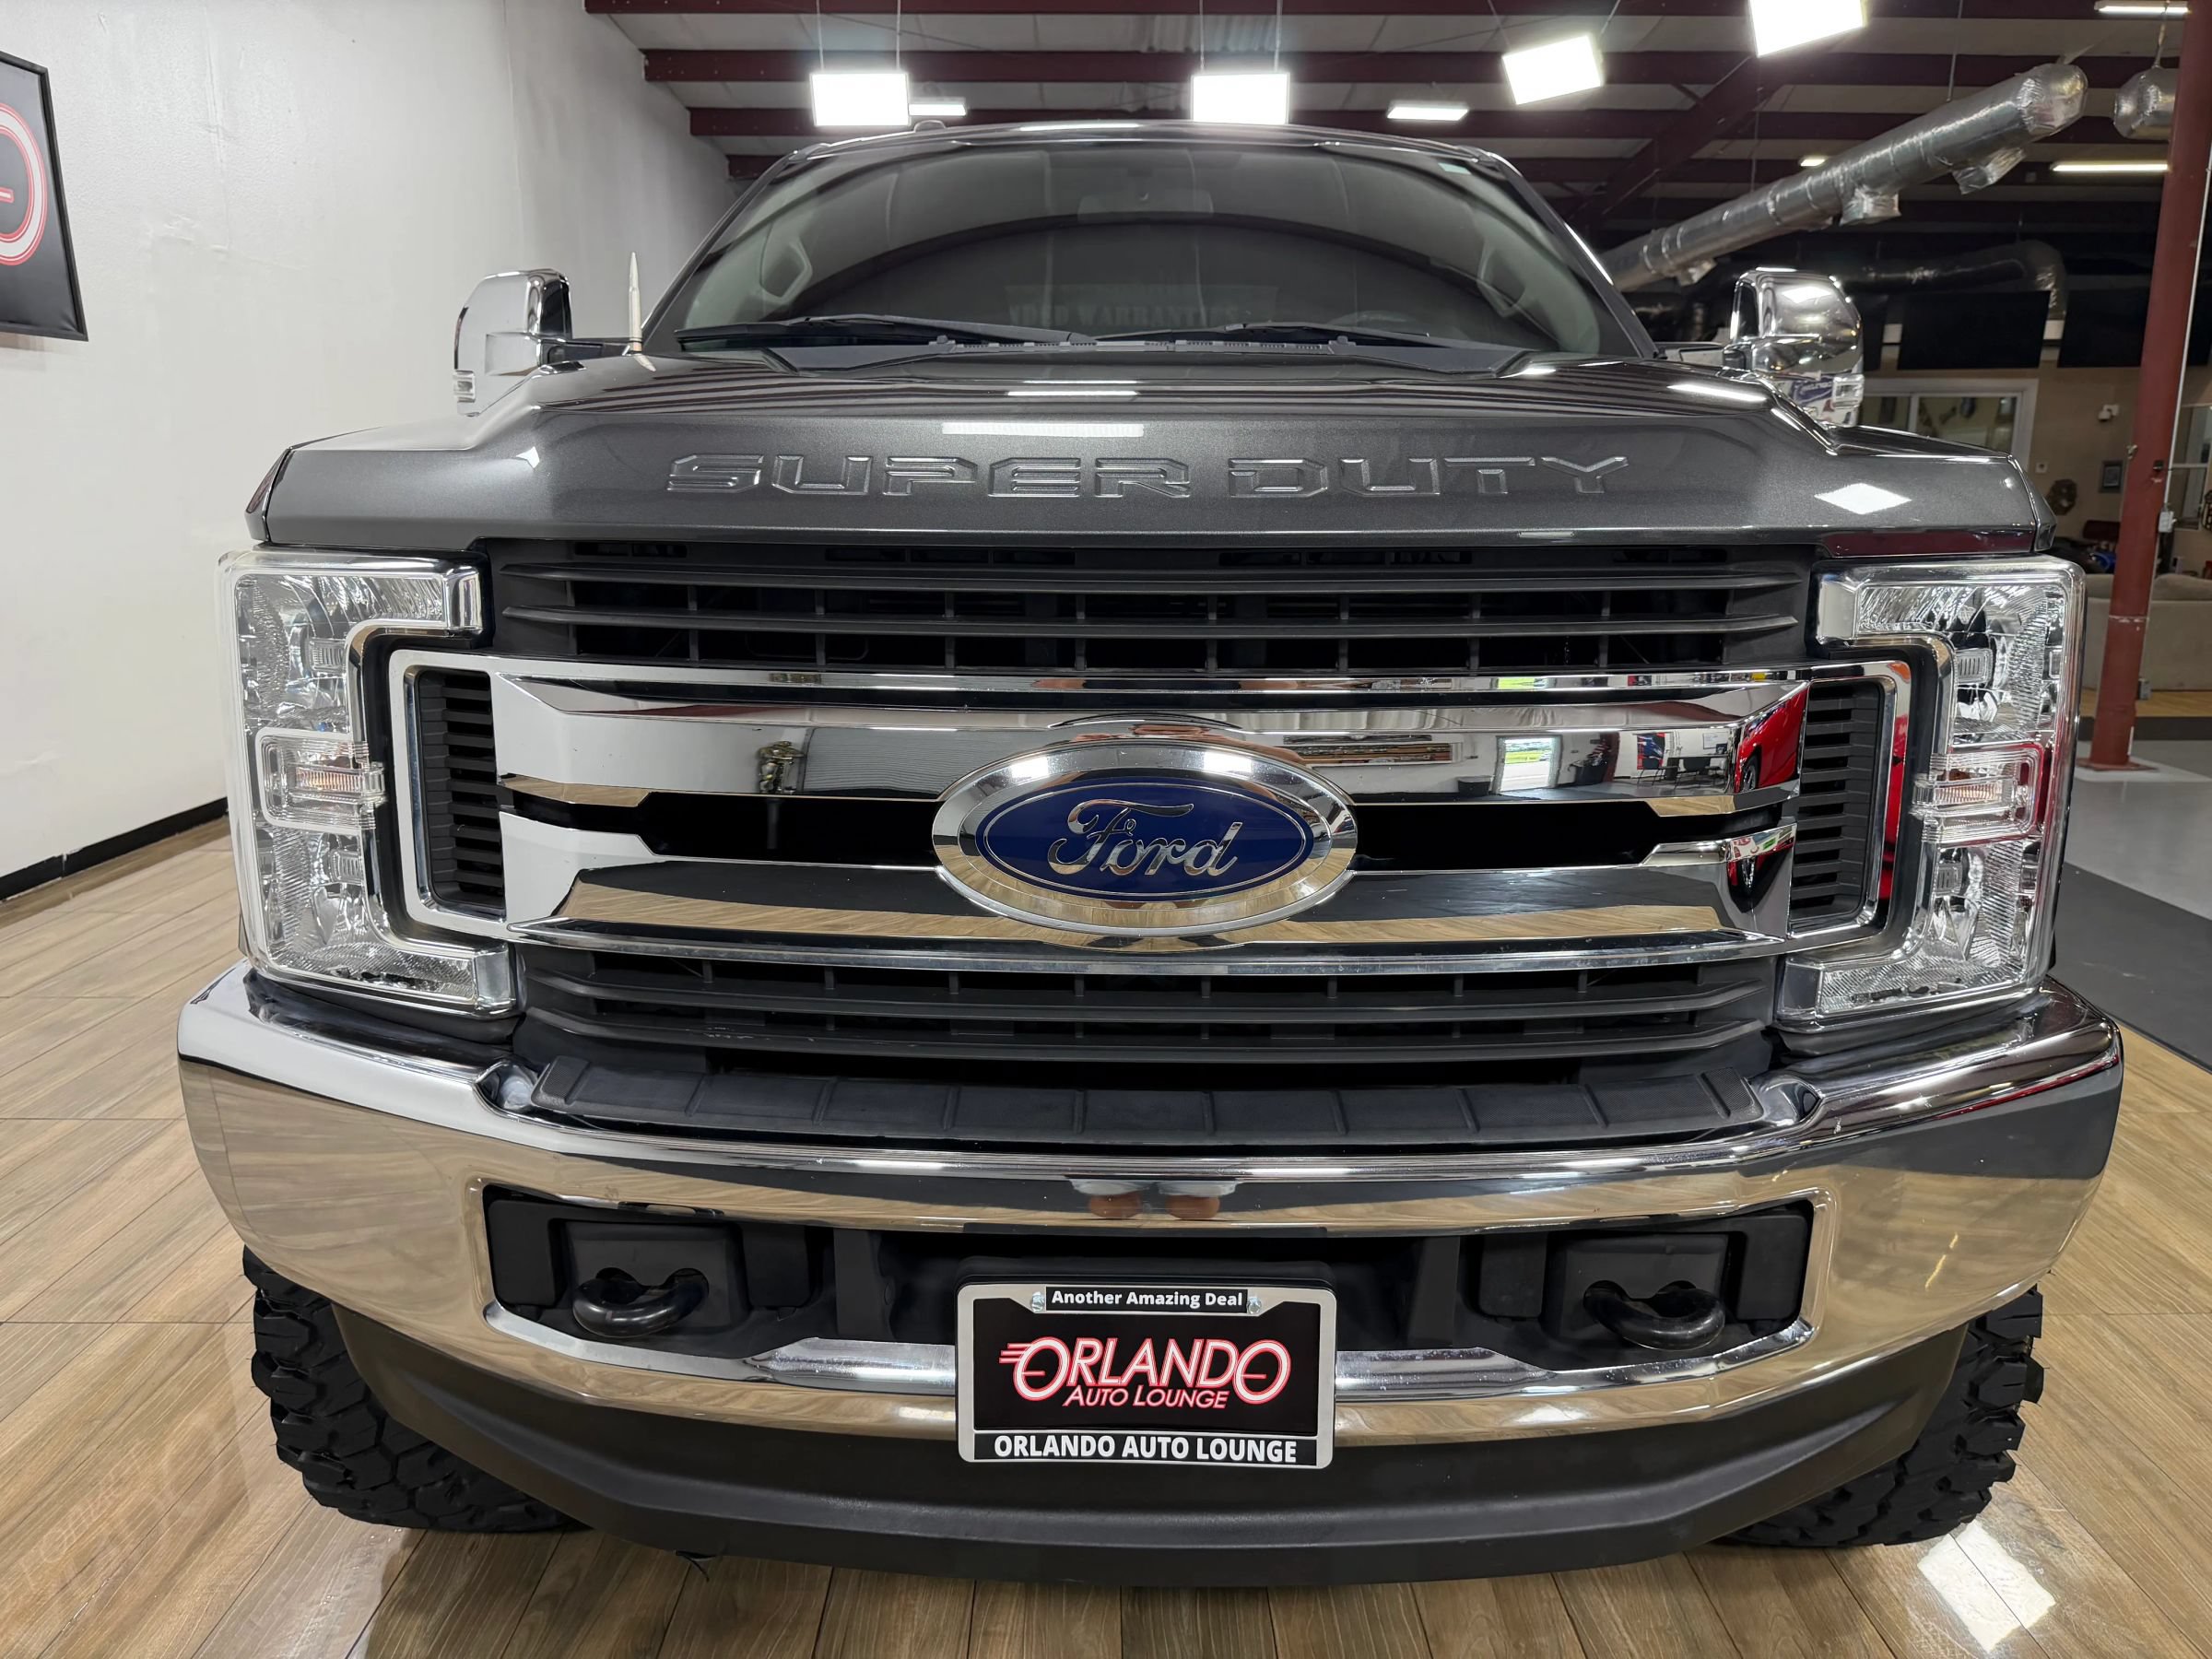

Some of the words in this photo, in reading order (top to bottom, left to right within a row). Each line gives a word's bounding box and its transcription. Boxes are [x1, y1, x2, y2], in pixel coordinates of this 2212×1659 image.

[666, 454, 1190, 498] SUPER
[1228, 456, 1629, 498] DUTY
[1047, 799, 1243, 876] Ford
[1052, 1290, 1123, 1306] Another
[1126, 1291, 1200, 1309] Amazing
[1205, 1292, 1242, 1306] Deal
[999, 1336, 1291, 1405] ORLANDO
[1062, 1387, 1129, 1407] AUTO
[1133, 1384, 1230, 1409] LOUNGE
[994, 1435, 1115, 1458] ORLANDO
[1122, 1437, 1189, 1459] AUTO
[1196, 1438, 1297, 1463] LOUNGE
